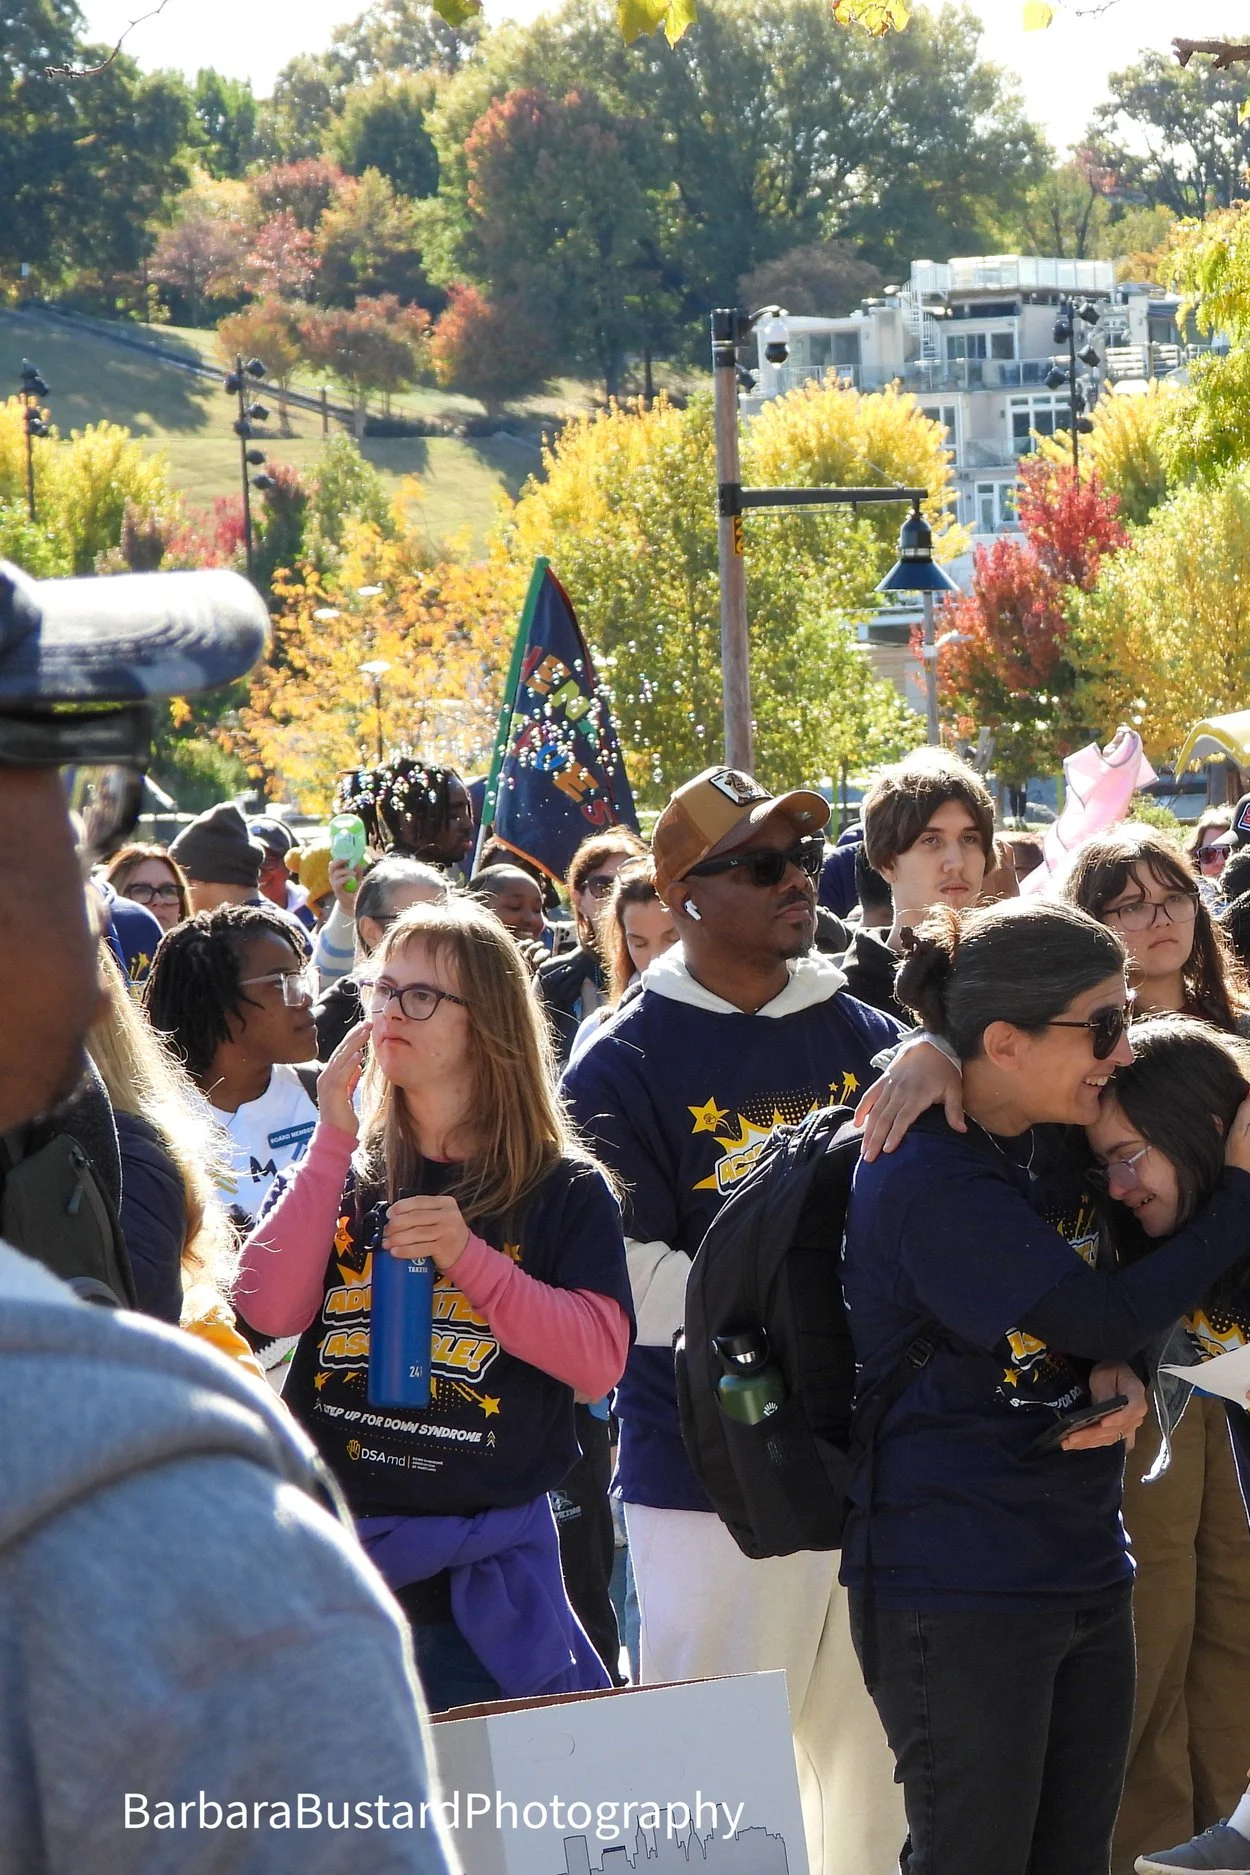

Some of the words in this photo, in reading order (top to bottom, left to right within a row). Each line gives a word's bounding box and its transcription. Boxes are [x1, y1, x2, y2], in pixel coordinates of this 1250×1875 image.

[270, 1133, 291, 1144] BOARD
[344, 1410, 361, 1421] UP
[360, 1413, 384, 1427] FOR
[384, 1418, 420, 1433] DOWN
[418, 1424, 482, 1443] SYNDROME
[361, 1448, 406, 1467] DSAmd
